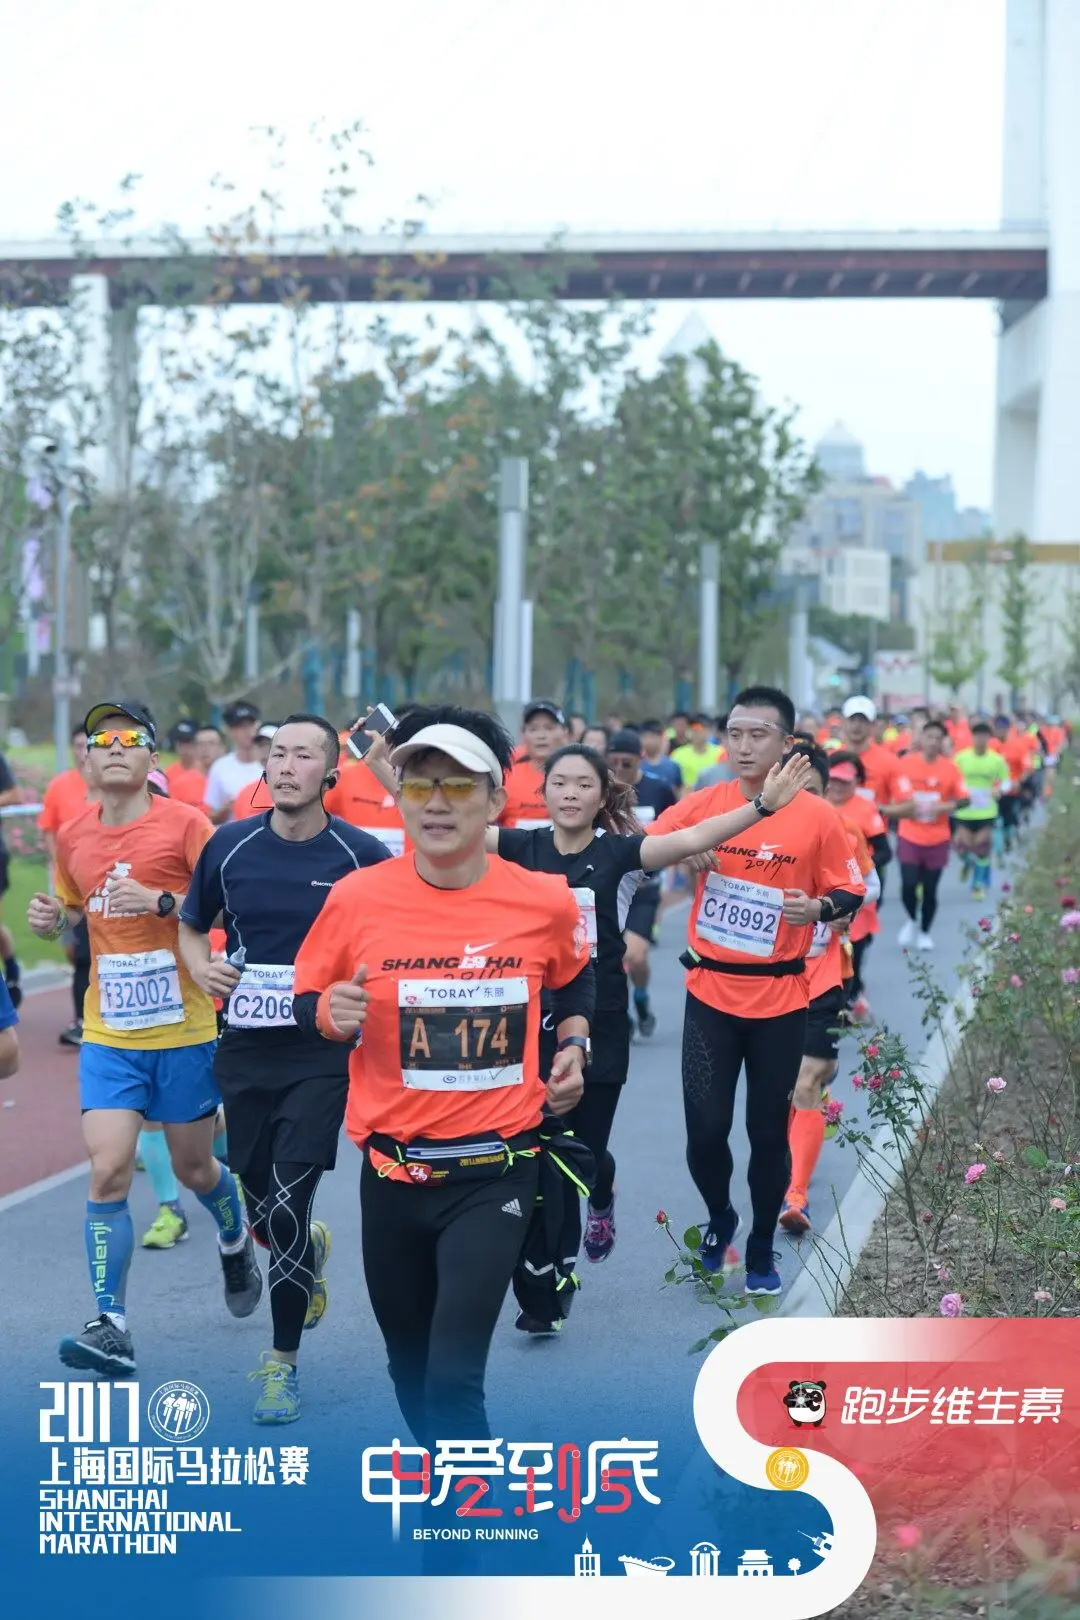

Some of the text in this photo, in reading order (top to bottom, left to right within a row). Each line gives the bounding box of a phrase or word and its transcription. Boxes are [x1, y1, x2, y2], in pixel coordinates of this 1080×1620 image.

[704, 898, 776, 934] C18992
[409, 1016, 509, 1058] A 174
